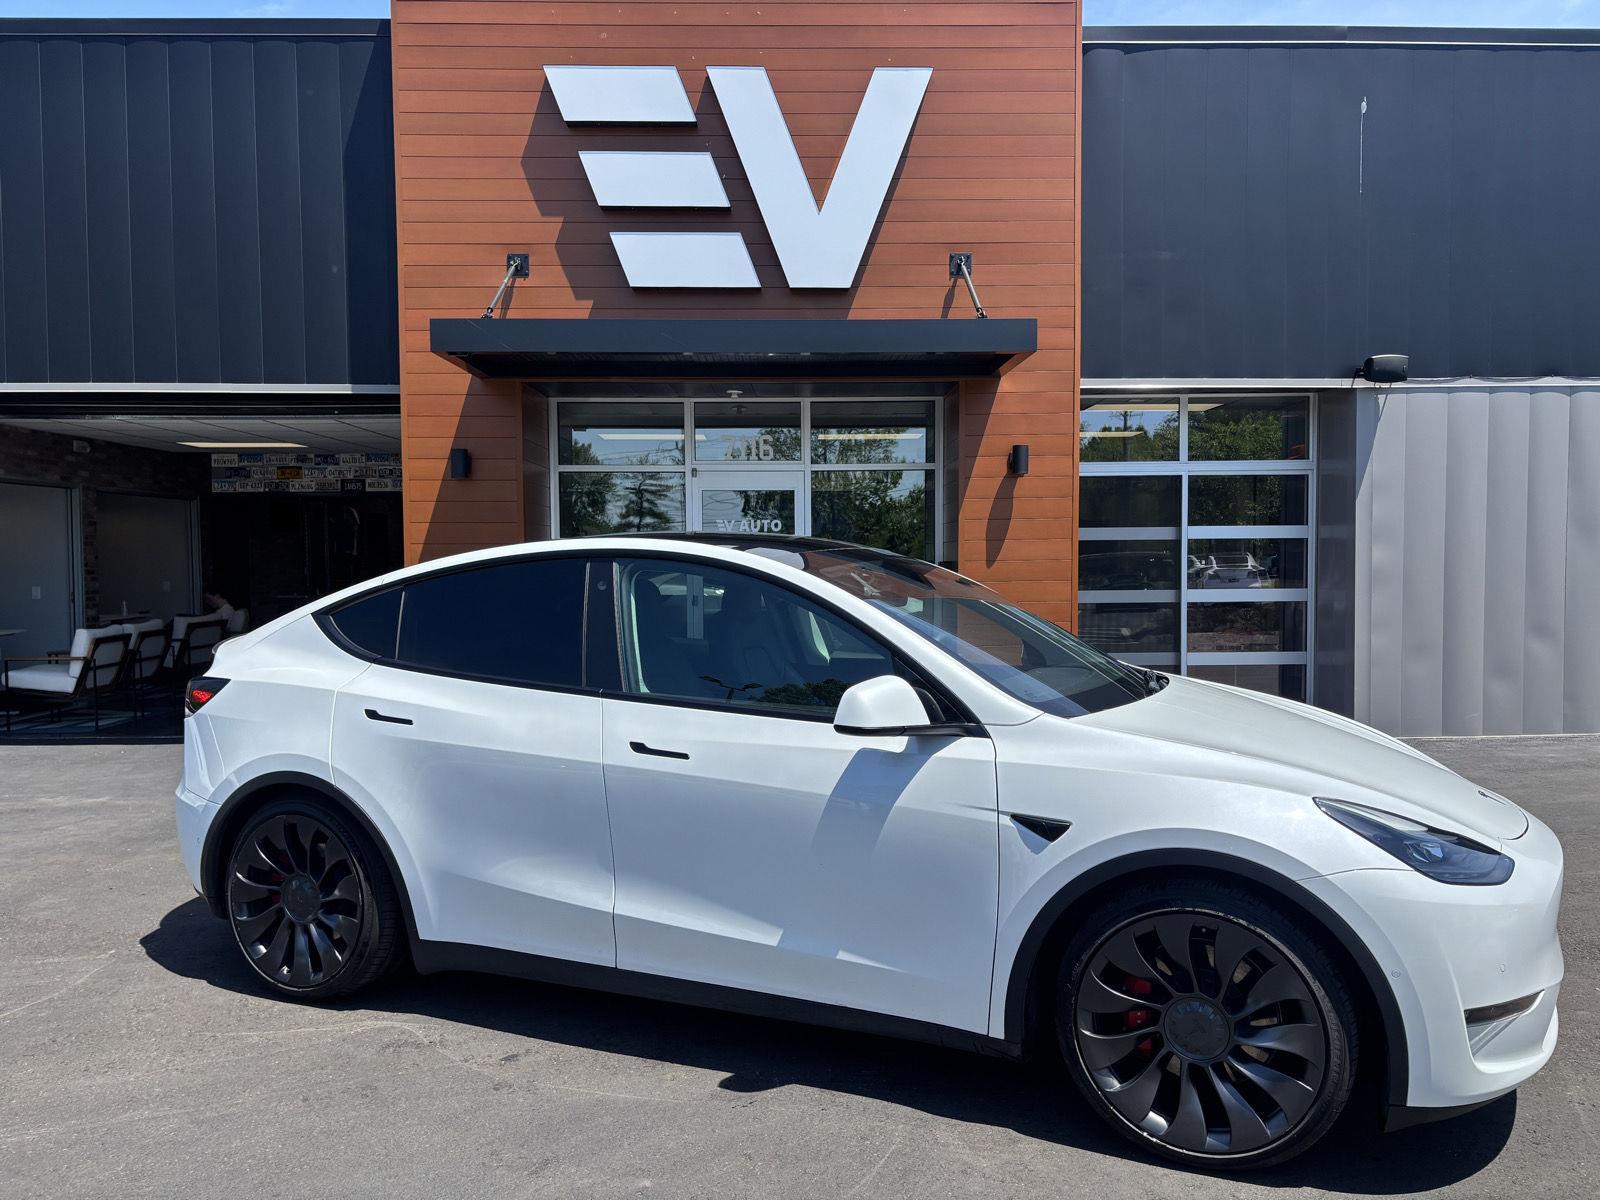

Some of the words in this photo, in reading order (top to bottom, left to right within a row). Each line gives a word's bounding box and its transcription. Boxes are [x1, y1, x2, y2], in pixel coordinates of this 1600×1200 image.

[543, 65, 933, 290] EV
[715, 519, 735, 532] EV
[739, 519, 782, 532] AUTO
